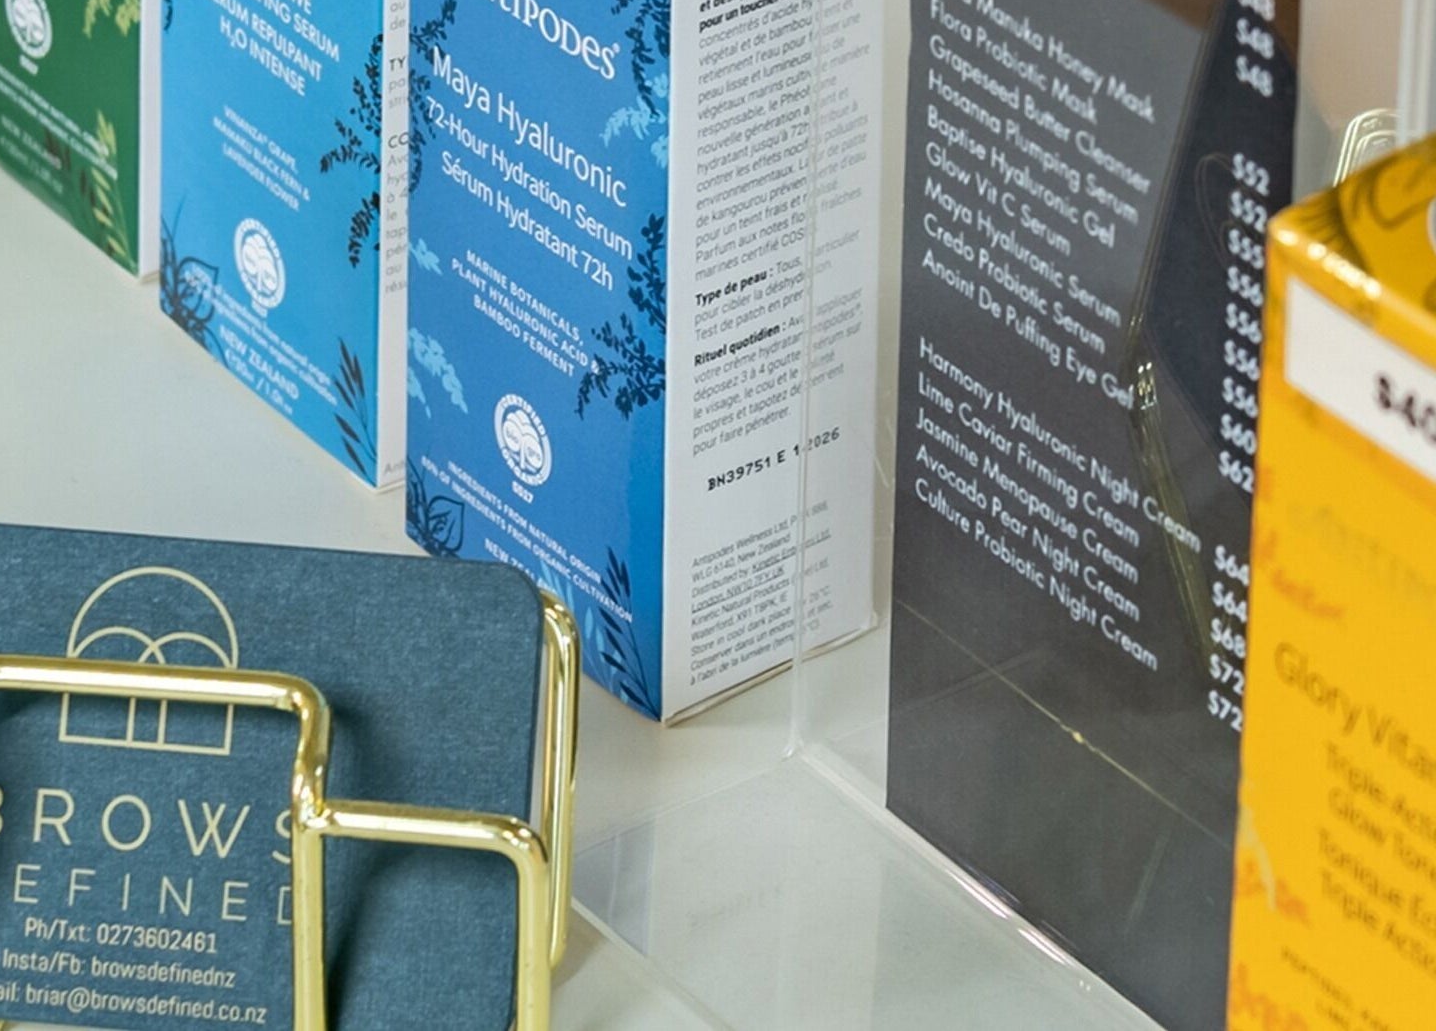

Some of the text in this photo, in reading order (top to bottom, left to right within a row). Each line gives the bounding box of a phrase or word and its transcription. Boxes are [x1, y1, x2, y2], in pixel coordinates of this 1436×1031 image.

[249, 39, 305, 96] INTENSE
[251, 14, 322, 81] REPULPANT
[293, 13, 340, 62] SERUM
[976, 27, 1046, 92] Probiotic
[1051, 78, 1096, 123] Mask
[1047, 37, 1103, 94] Honey
[1107, 77, 1154, 123] Mask
[433, 46, 626, 207] Maya Hyaluronic
[928, 70, 1138, 224] Hosanna Plumping Serum
[929, 35, 1150, 193] Grapeseed Butter Cleanser
[426, 96, 633, 261] 72-Hour Hydration Serum
[441, 151, 613, 291] Sérum Hydratant 72h
[925, 142, 1071, 256] Glow Vit C Serum
[927, 105, 1115, 248] Baptise Hyaluronic Gel
[466, 250, 584, 347] MARINE BOTANICALS,
[695, 270, 768, 307] Type de peau
[923, 213, 1105, 354] Credo Probiotic Serum
[924, 178, 1120, 326] Maya Hyaluronic Serum
[451, 258, 487, 293] PLANT
[488, 287, 559, 347] HYALURONIC
[560, 340, 589, 367] ACID
[473, 294, 575, 377] BAMBOO FERMENT
[693, 324, 780, 367] Rituel quotidien
[922, 249, 1134, 410] Anoint De Puffing Eye Gel
[707, 449, 786, 491] BN39751 E
[916, 408, 1139, 584] Jasmine Menopause Cream
[918, 372, 1140, 547] Lime Caviar Firming Cream
[919, 338, 1201, 553] Harmony Hyaluronic Night Cream
[915, 478, 1158, 671] Culture Probiotic Night Cream
[916, 445, 1140, 622] Avocado Pear Night Cream
[1, 948, 236, 989] Insta/Fb: browsdefinednz
[24, 916, 218, 955] Ph/Txt: 0273602461
[25, 983, 268, 1025] briar@browsdefined.co.nz
